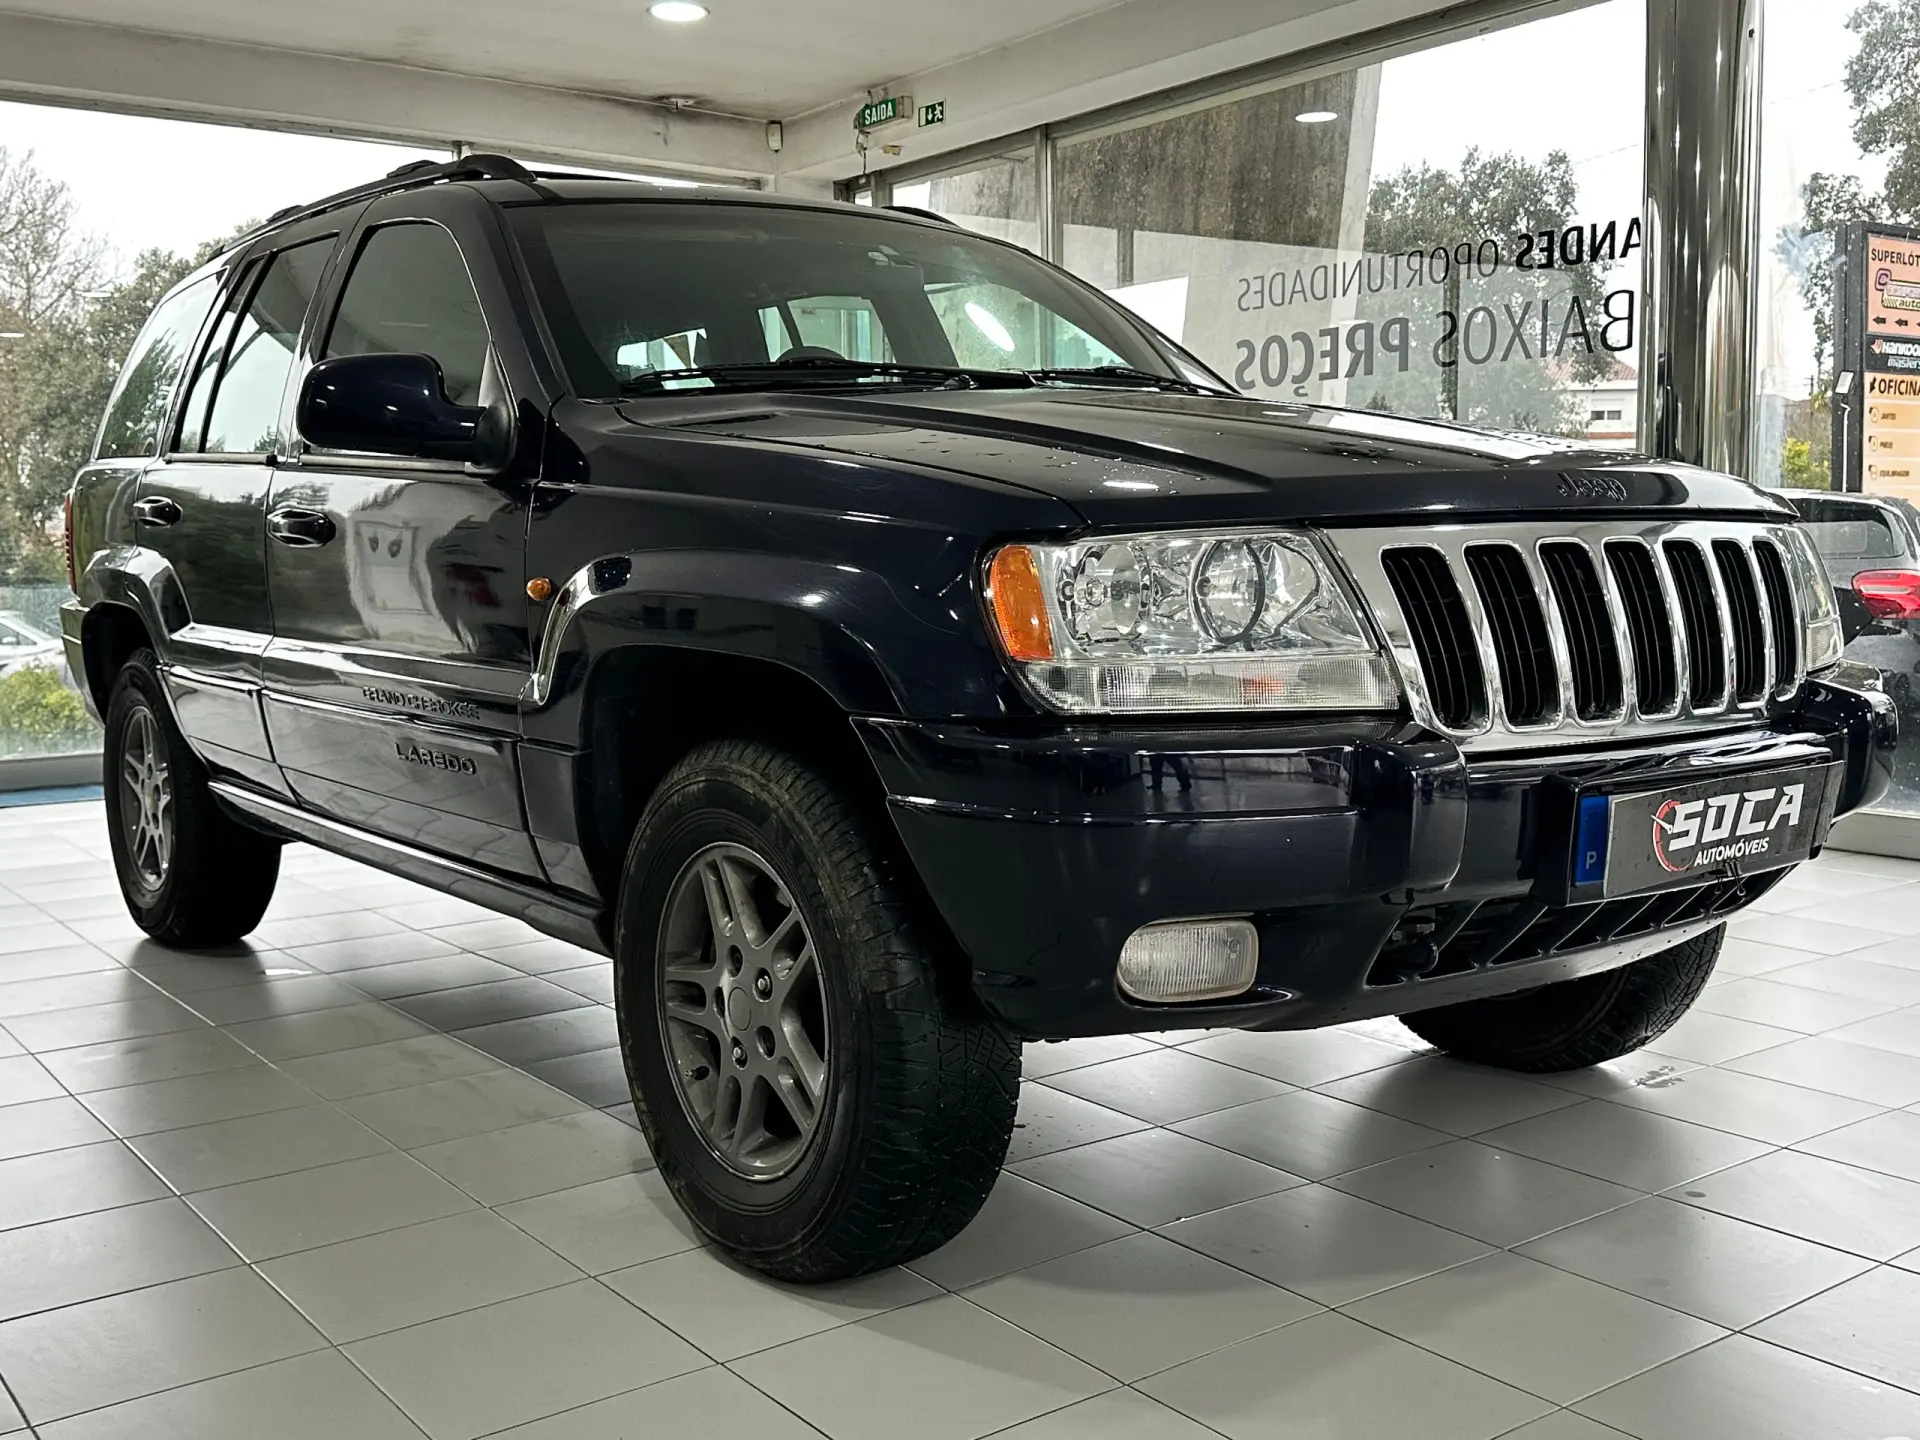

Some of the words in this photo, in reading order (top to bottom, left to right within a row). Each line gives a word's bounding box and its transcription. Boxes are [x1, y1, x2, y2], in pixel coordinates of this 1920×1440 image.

[1882, 341, 1920, 356] Hankoo
[395, 742, 477, 775] LAREDO
[1668, 783, 1804, 851] SOCA
[1585, 851, 1597, 870] P
[1693, 837, 1769, 867] AUTOMÓVEIS
